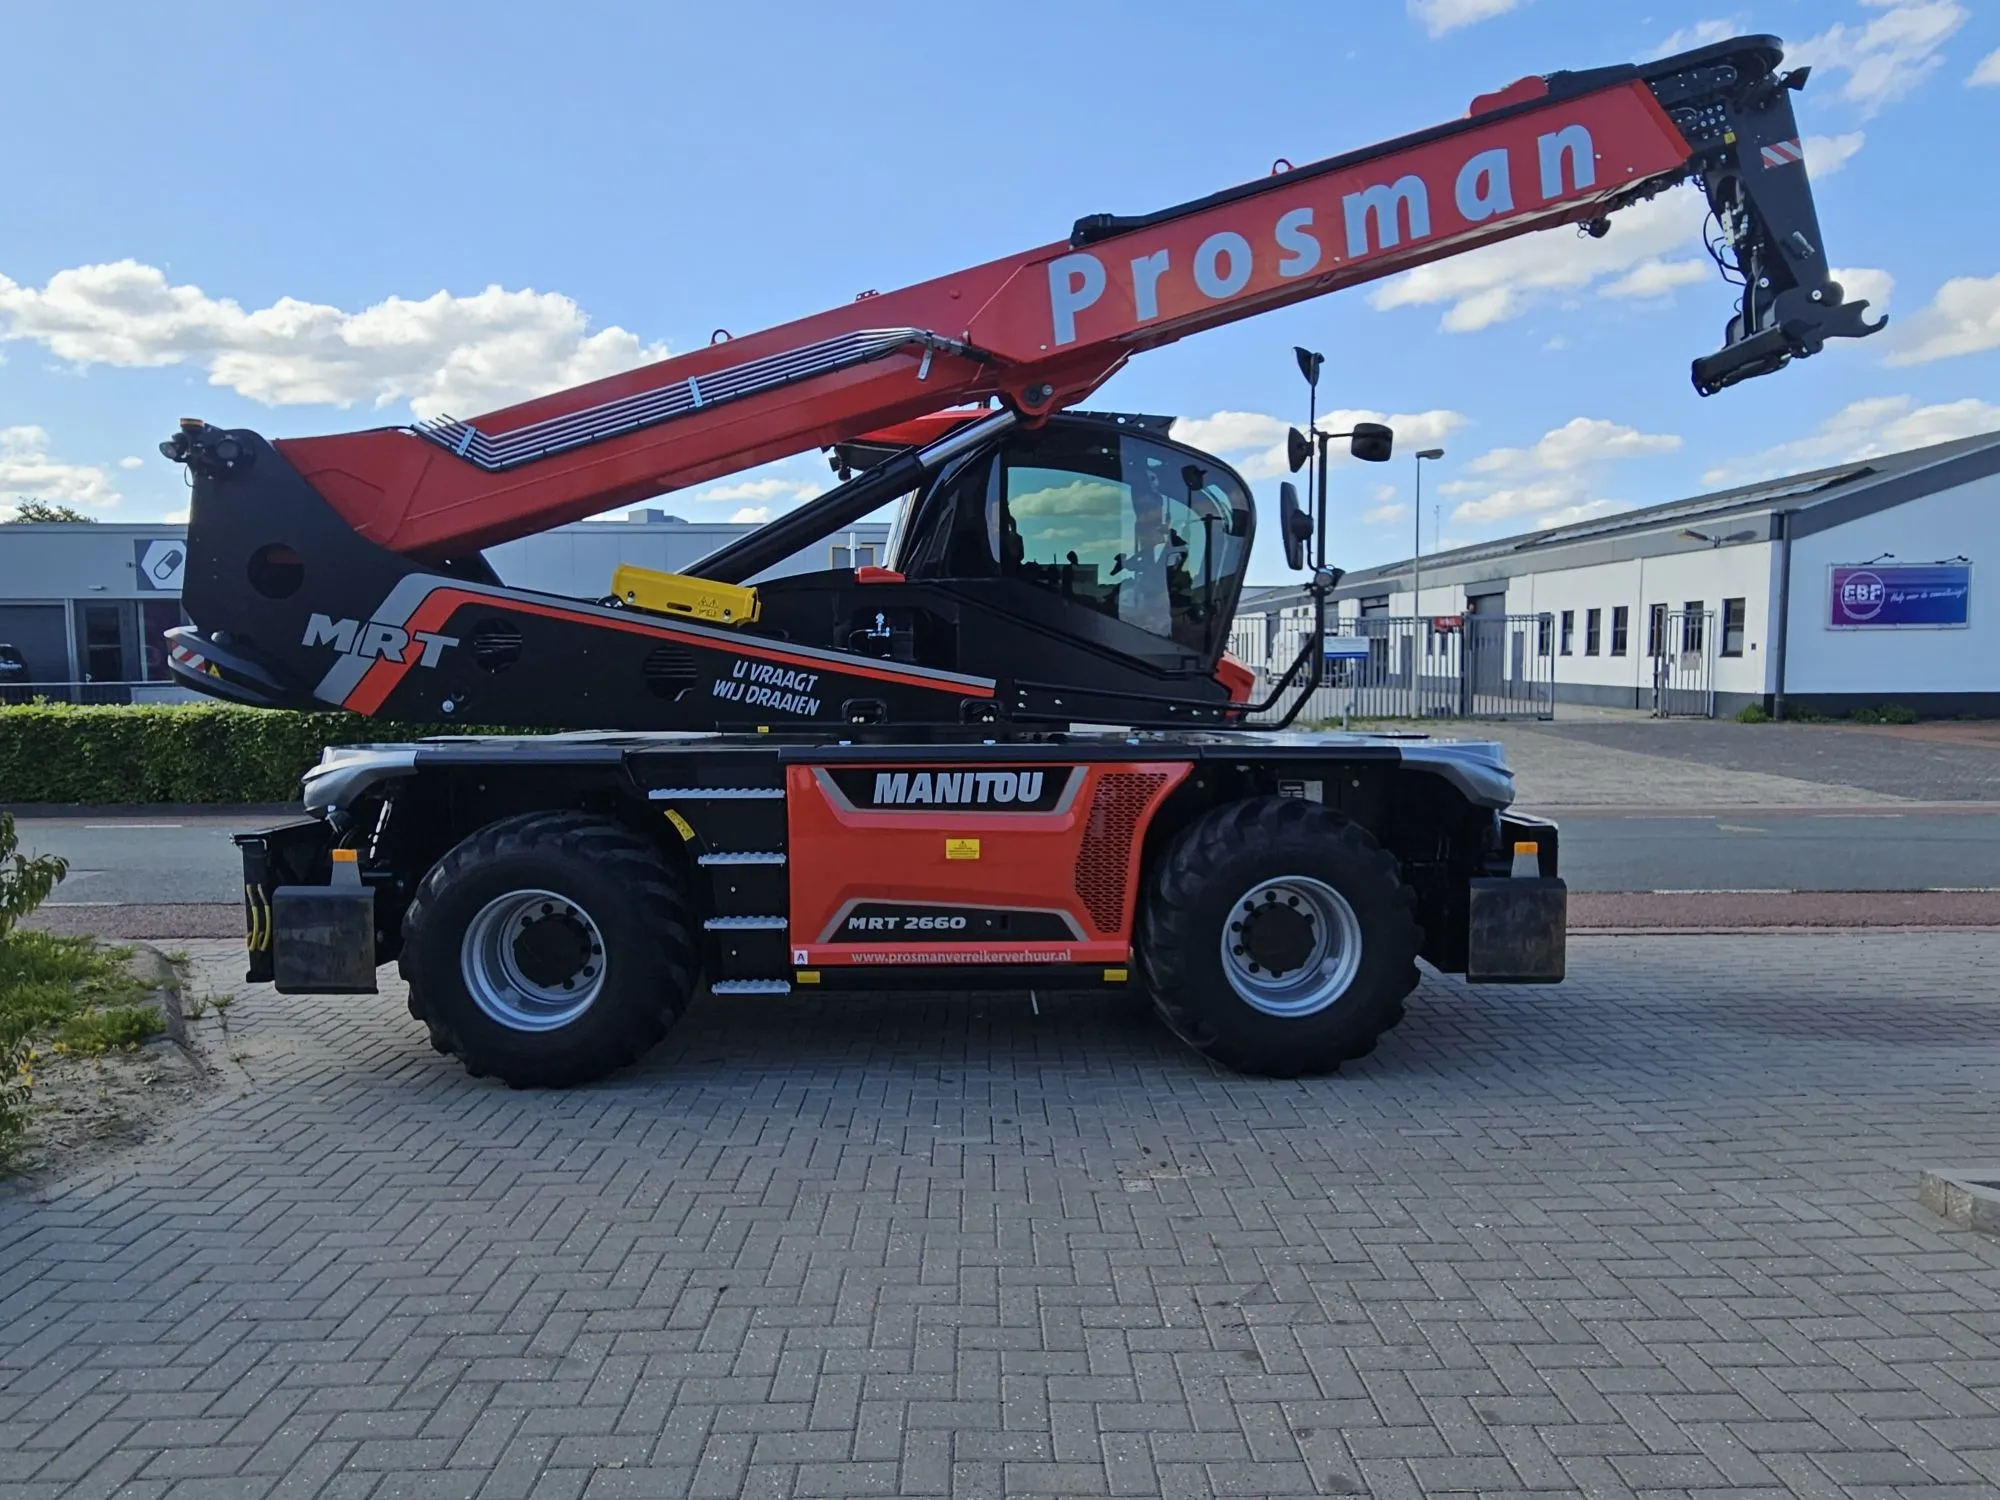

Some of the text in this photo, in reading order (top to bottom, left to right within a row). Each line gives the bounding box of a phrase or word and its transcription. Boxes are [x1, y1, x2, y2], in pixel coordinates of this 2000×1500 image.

[1047, 124, 1595, 346] Prosman
[1843, 584, 1882, 601] EBF
[301, 613, 460, 668] MRT
[733, 660, 818, 692] U VRAAGT
[713, 680, 820, 716] WIJ DRAAIEN
[873, 772, 1043, 804] MANITOU
[848, 917, 967, 930] MRT 2660
[796, 952, 806, 962] A
[852, 949, 1071, 964] www.prosmanverreikerverhuur.nl
